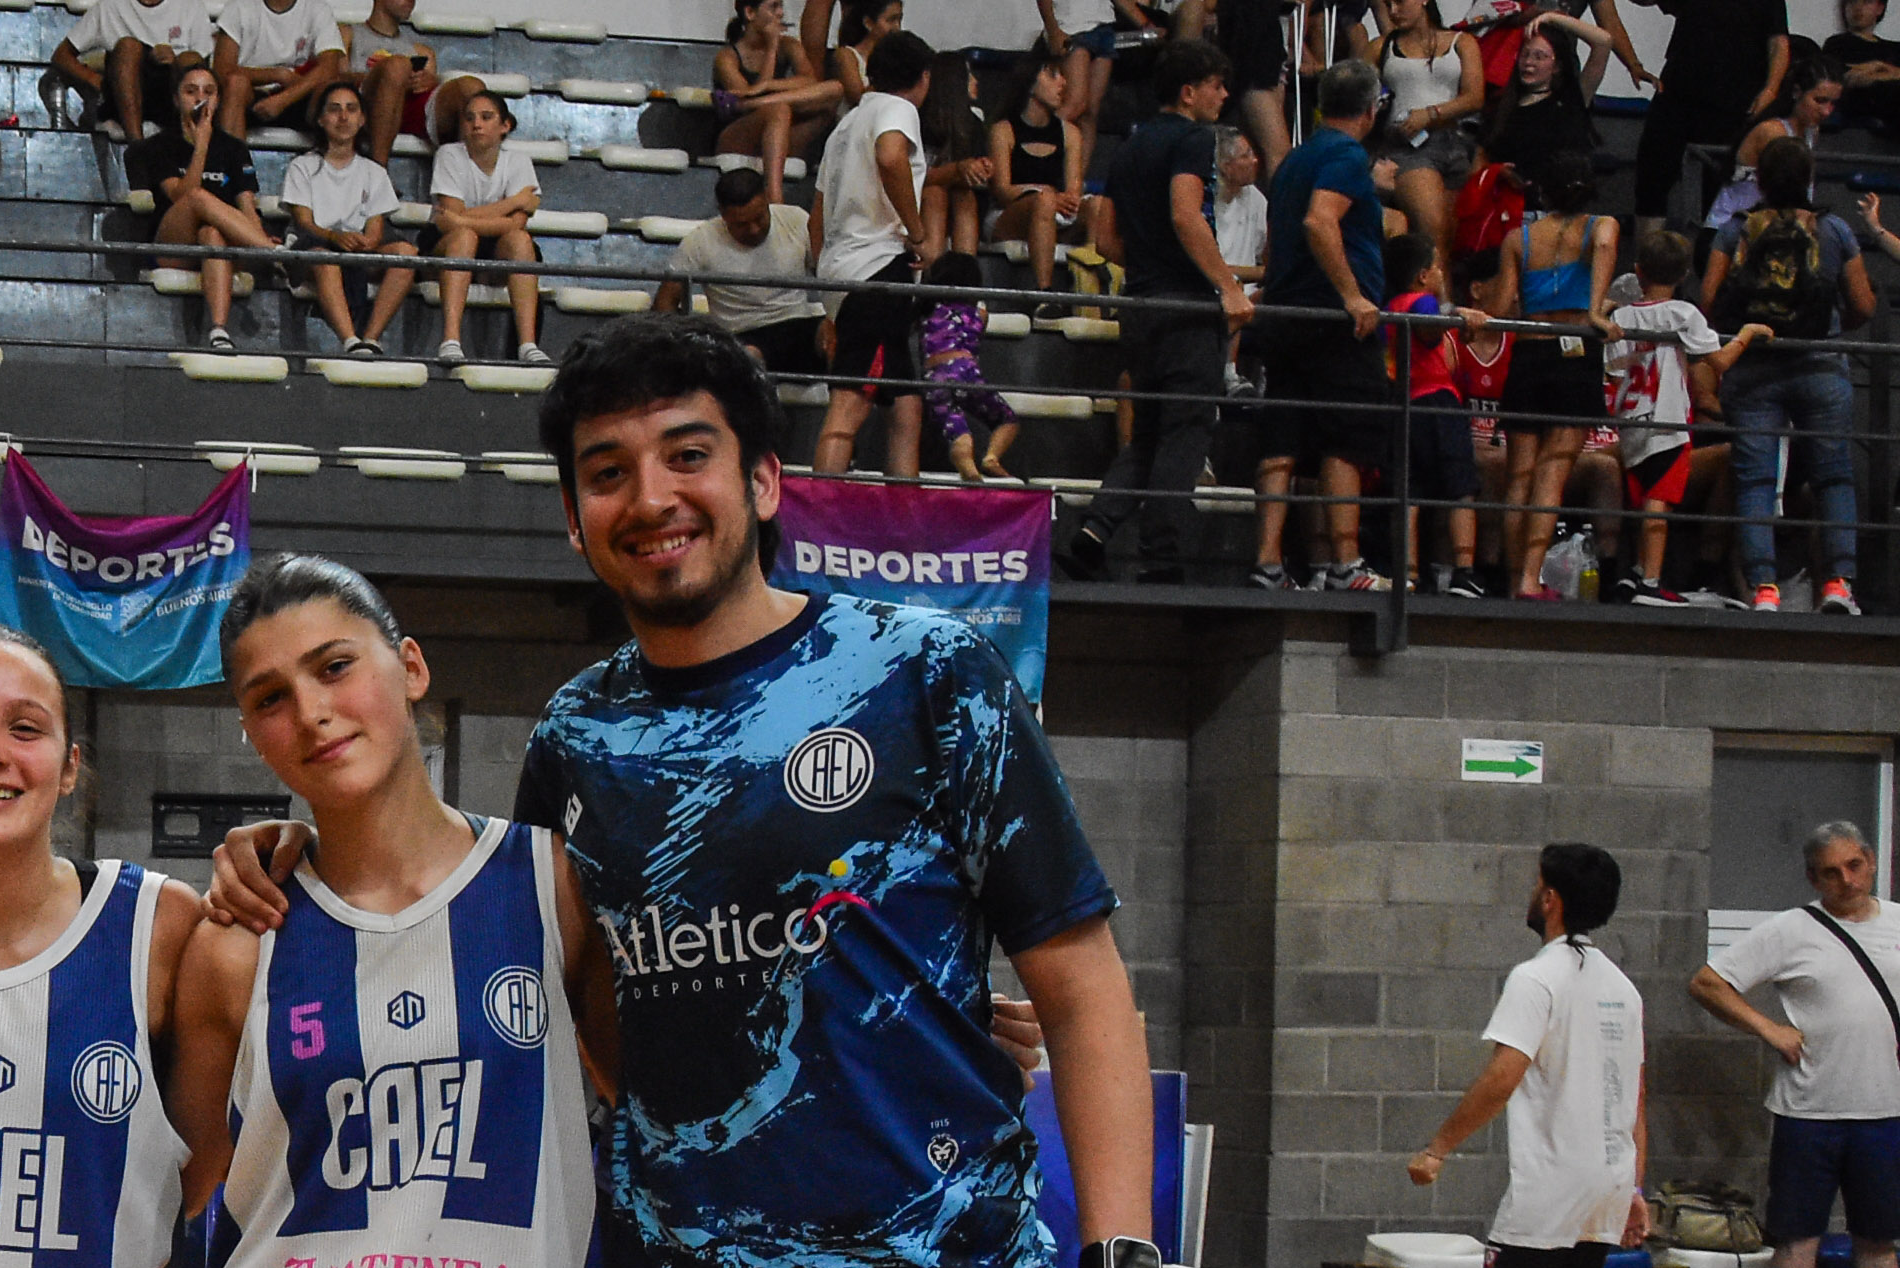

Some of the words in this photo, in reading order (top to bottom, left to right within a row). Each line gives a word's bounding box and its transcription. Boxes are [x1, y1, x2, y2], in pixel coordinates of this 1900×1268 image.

[795, 540, 1029, 583] DEPORTES
[209, 585, 238, 603] AIRE
[633, 968, 794, 1000] DEPORTES
[290, 1002, 326, 1060] 5
[322, 1059, 487, 1190] CAEL
[930, 1118, 950, 1129] 1915
